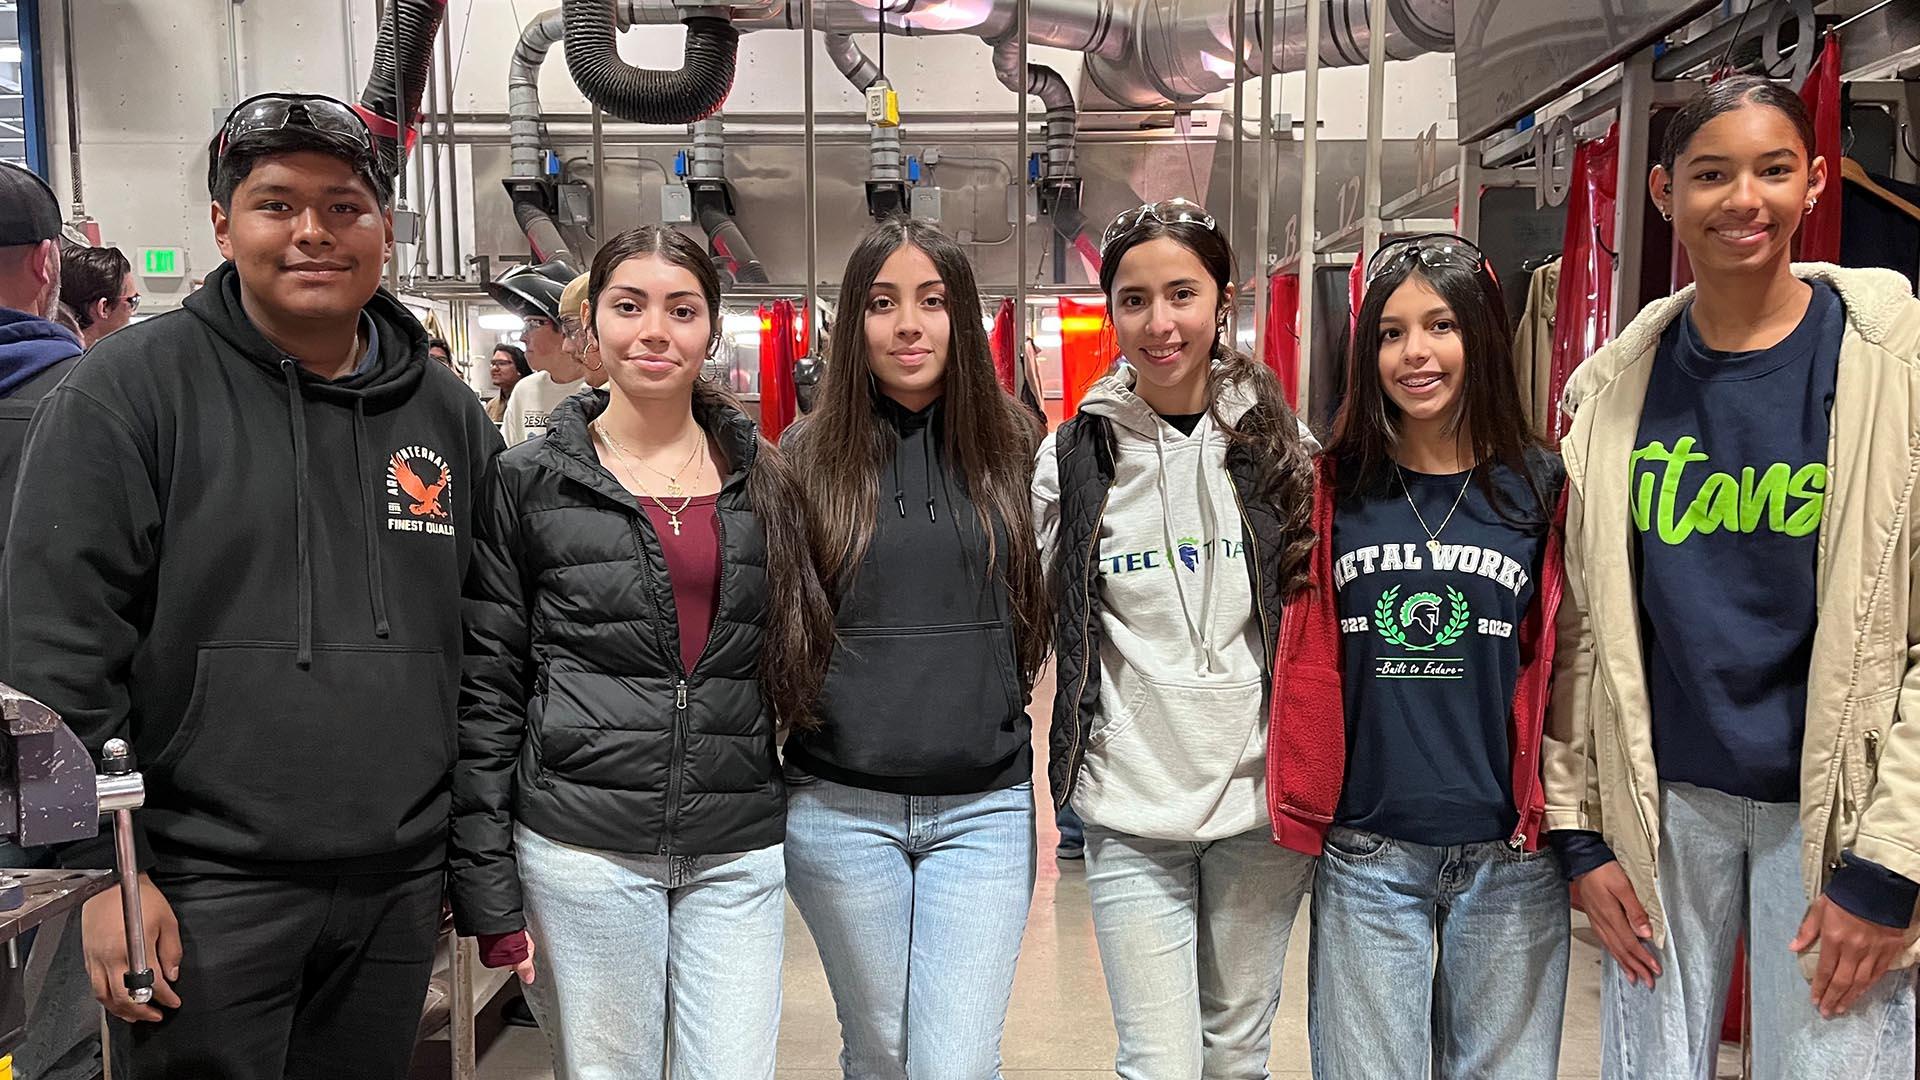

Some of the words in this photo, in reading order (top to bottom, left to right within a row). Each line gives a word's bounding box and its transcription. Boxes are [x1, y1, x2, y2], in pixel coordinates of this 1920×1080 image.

[1414, 122, 1437, 198] 11
[1531, 114, 1575, 210] 10
[387, 518, 424, 532] FINEST
[1477, 617, 1513, 638] 2023
[1410, 664, 1420, 674] to
